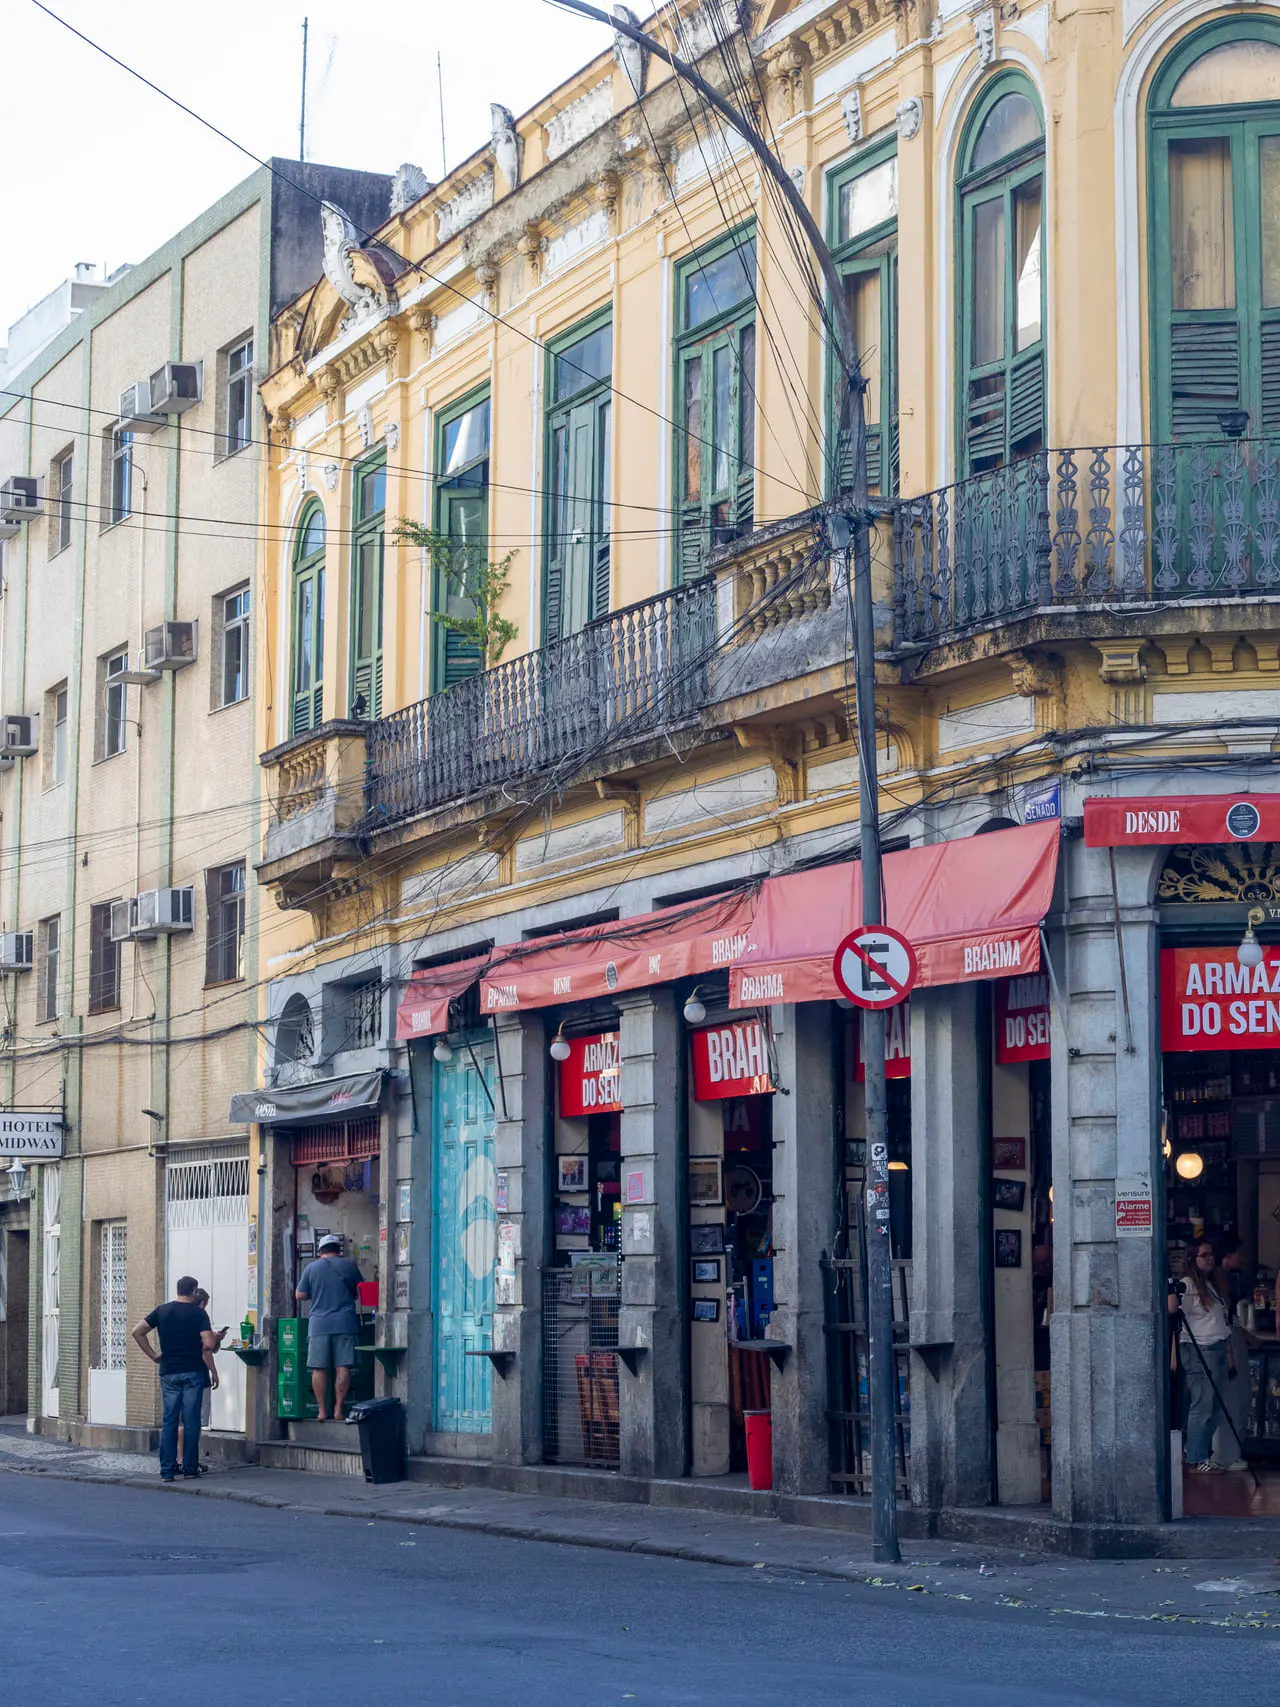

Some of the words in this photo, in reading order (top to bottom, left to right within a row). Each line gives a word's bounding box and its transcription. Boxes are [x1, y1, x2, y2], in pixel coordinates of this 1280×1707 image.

[1025, 803, 1056, 820] SENADO
[1124, 810, 1181, 834] DESDE
[964, 940, 1021, 974] BRAHMA
[740, 974, 784, 1001] BRAHMA
[1005, 1016, 1027, 1049] DO
[1182, 1002, 1222, 1036] DO
[583, 1039, 624, 1073] ARMAZ
[582, 1078, 596, 1107] DO
[3, 1121, 55, 1133] HOTEL
[1118, 1201, 1150, 1211] Alarme
